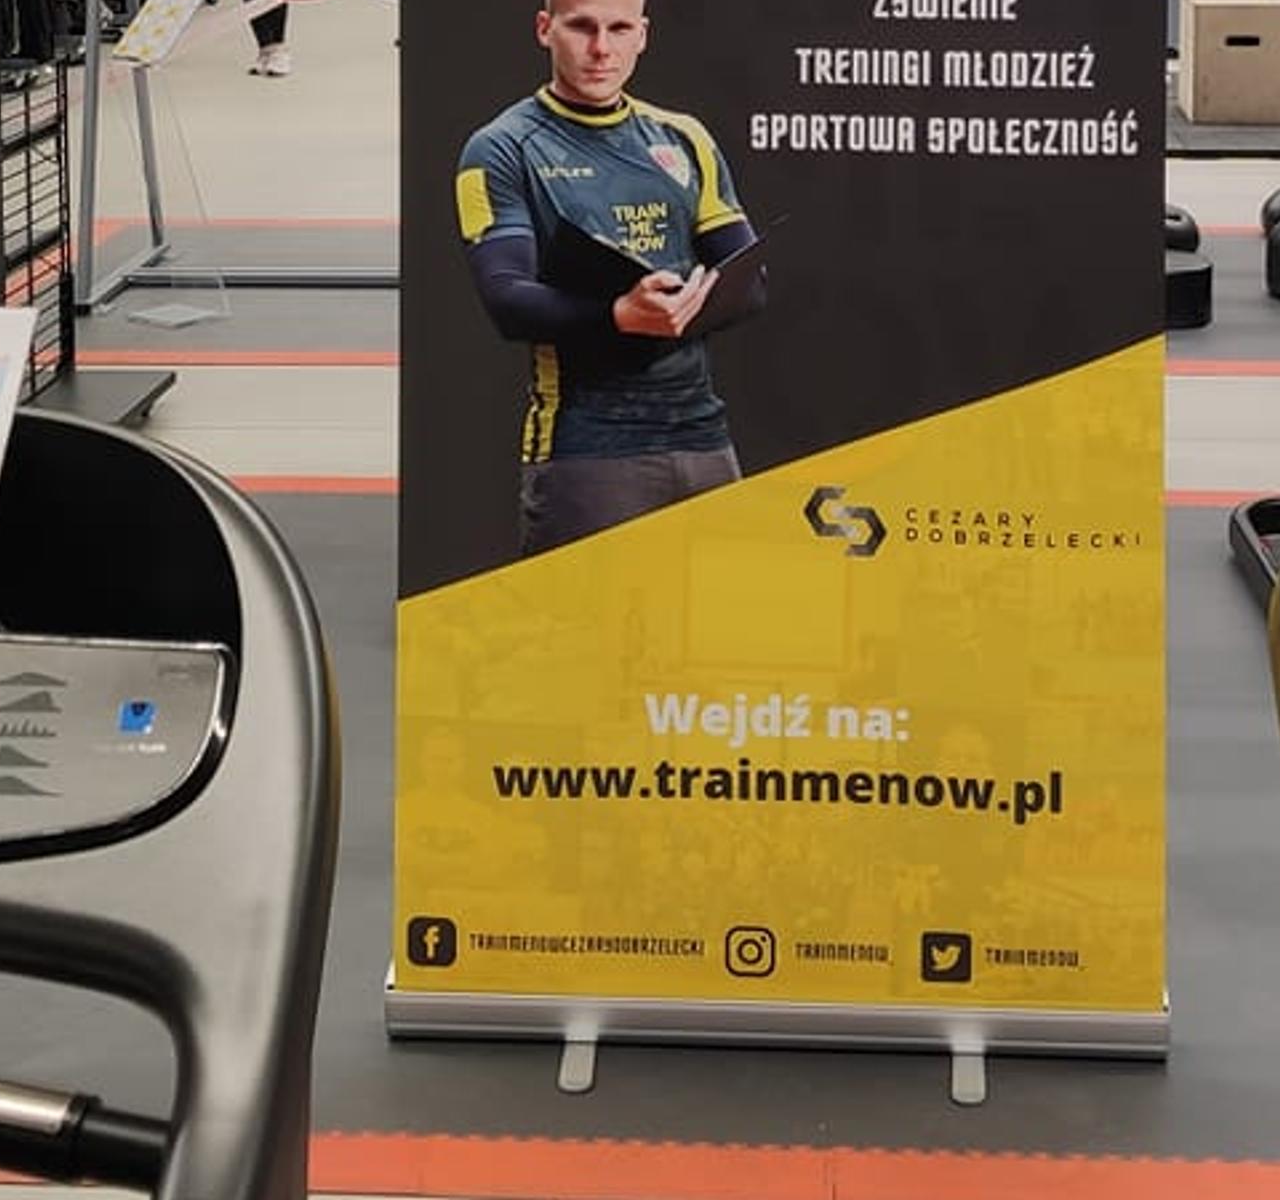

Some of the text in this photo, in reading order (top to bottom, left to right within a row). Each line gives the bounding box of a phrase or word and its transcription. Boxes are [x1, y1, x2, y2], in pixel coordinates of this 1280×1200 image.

[795, 45, 1096, 88] TRENINGI MŁODZIEŻ
[751, 110, 1139, 156] SPORTOWA SPOŁECZNOŚĆ
[612, 202, 667, 221] TRAIN
[906, 508, 1039, 527] CEZARY
[906, 528, 1141, 548] DOBRZELECKI
[645, 693, 912, 749] Wejdź na:
[492, 758, 1064, 825] www.trainmenow.pl
